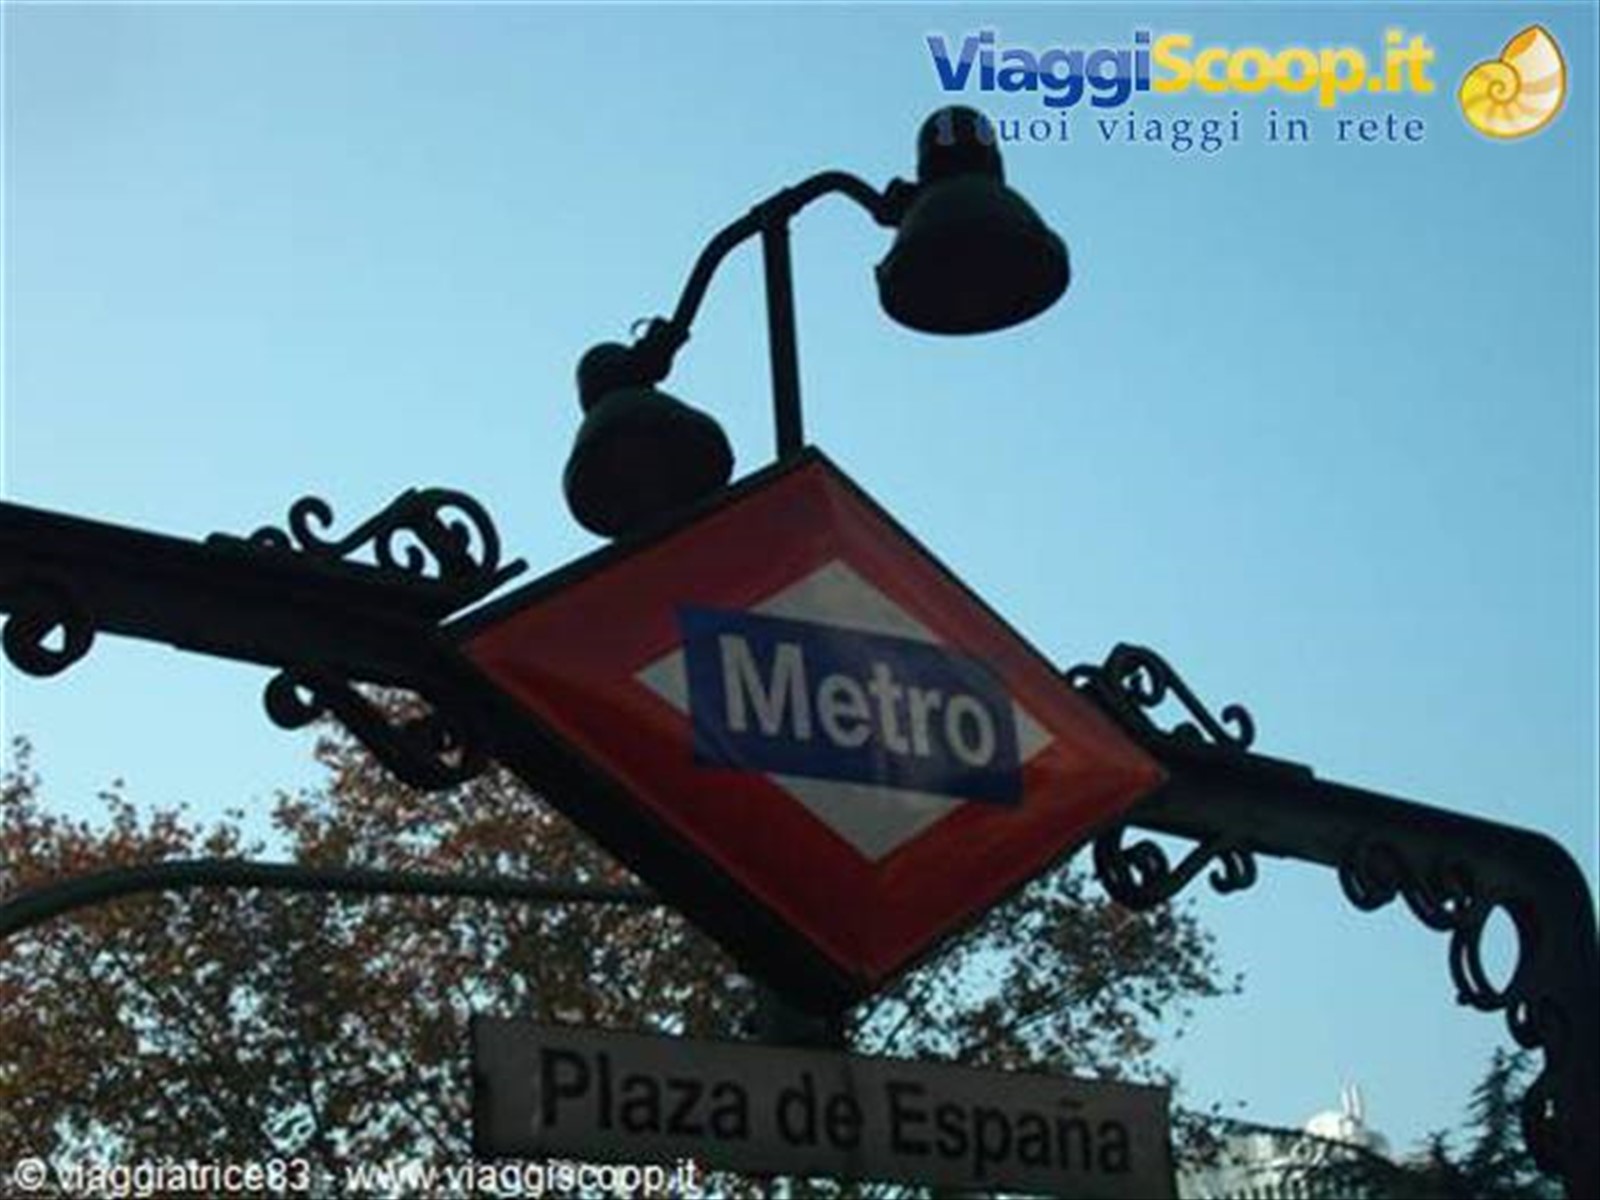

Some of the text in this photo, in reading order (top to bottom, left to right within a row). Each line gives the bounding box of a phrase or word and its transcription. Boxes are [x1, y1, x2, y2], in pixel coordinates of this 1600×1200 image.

[719, 634, 996, 768] Metro
[540, 1048, 1132, 1178] Plaza de España
